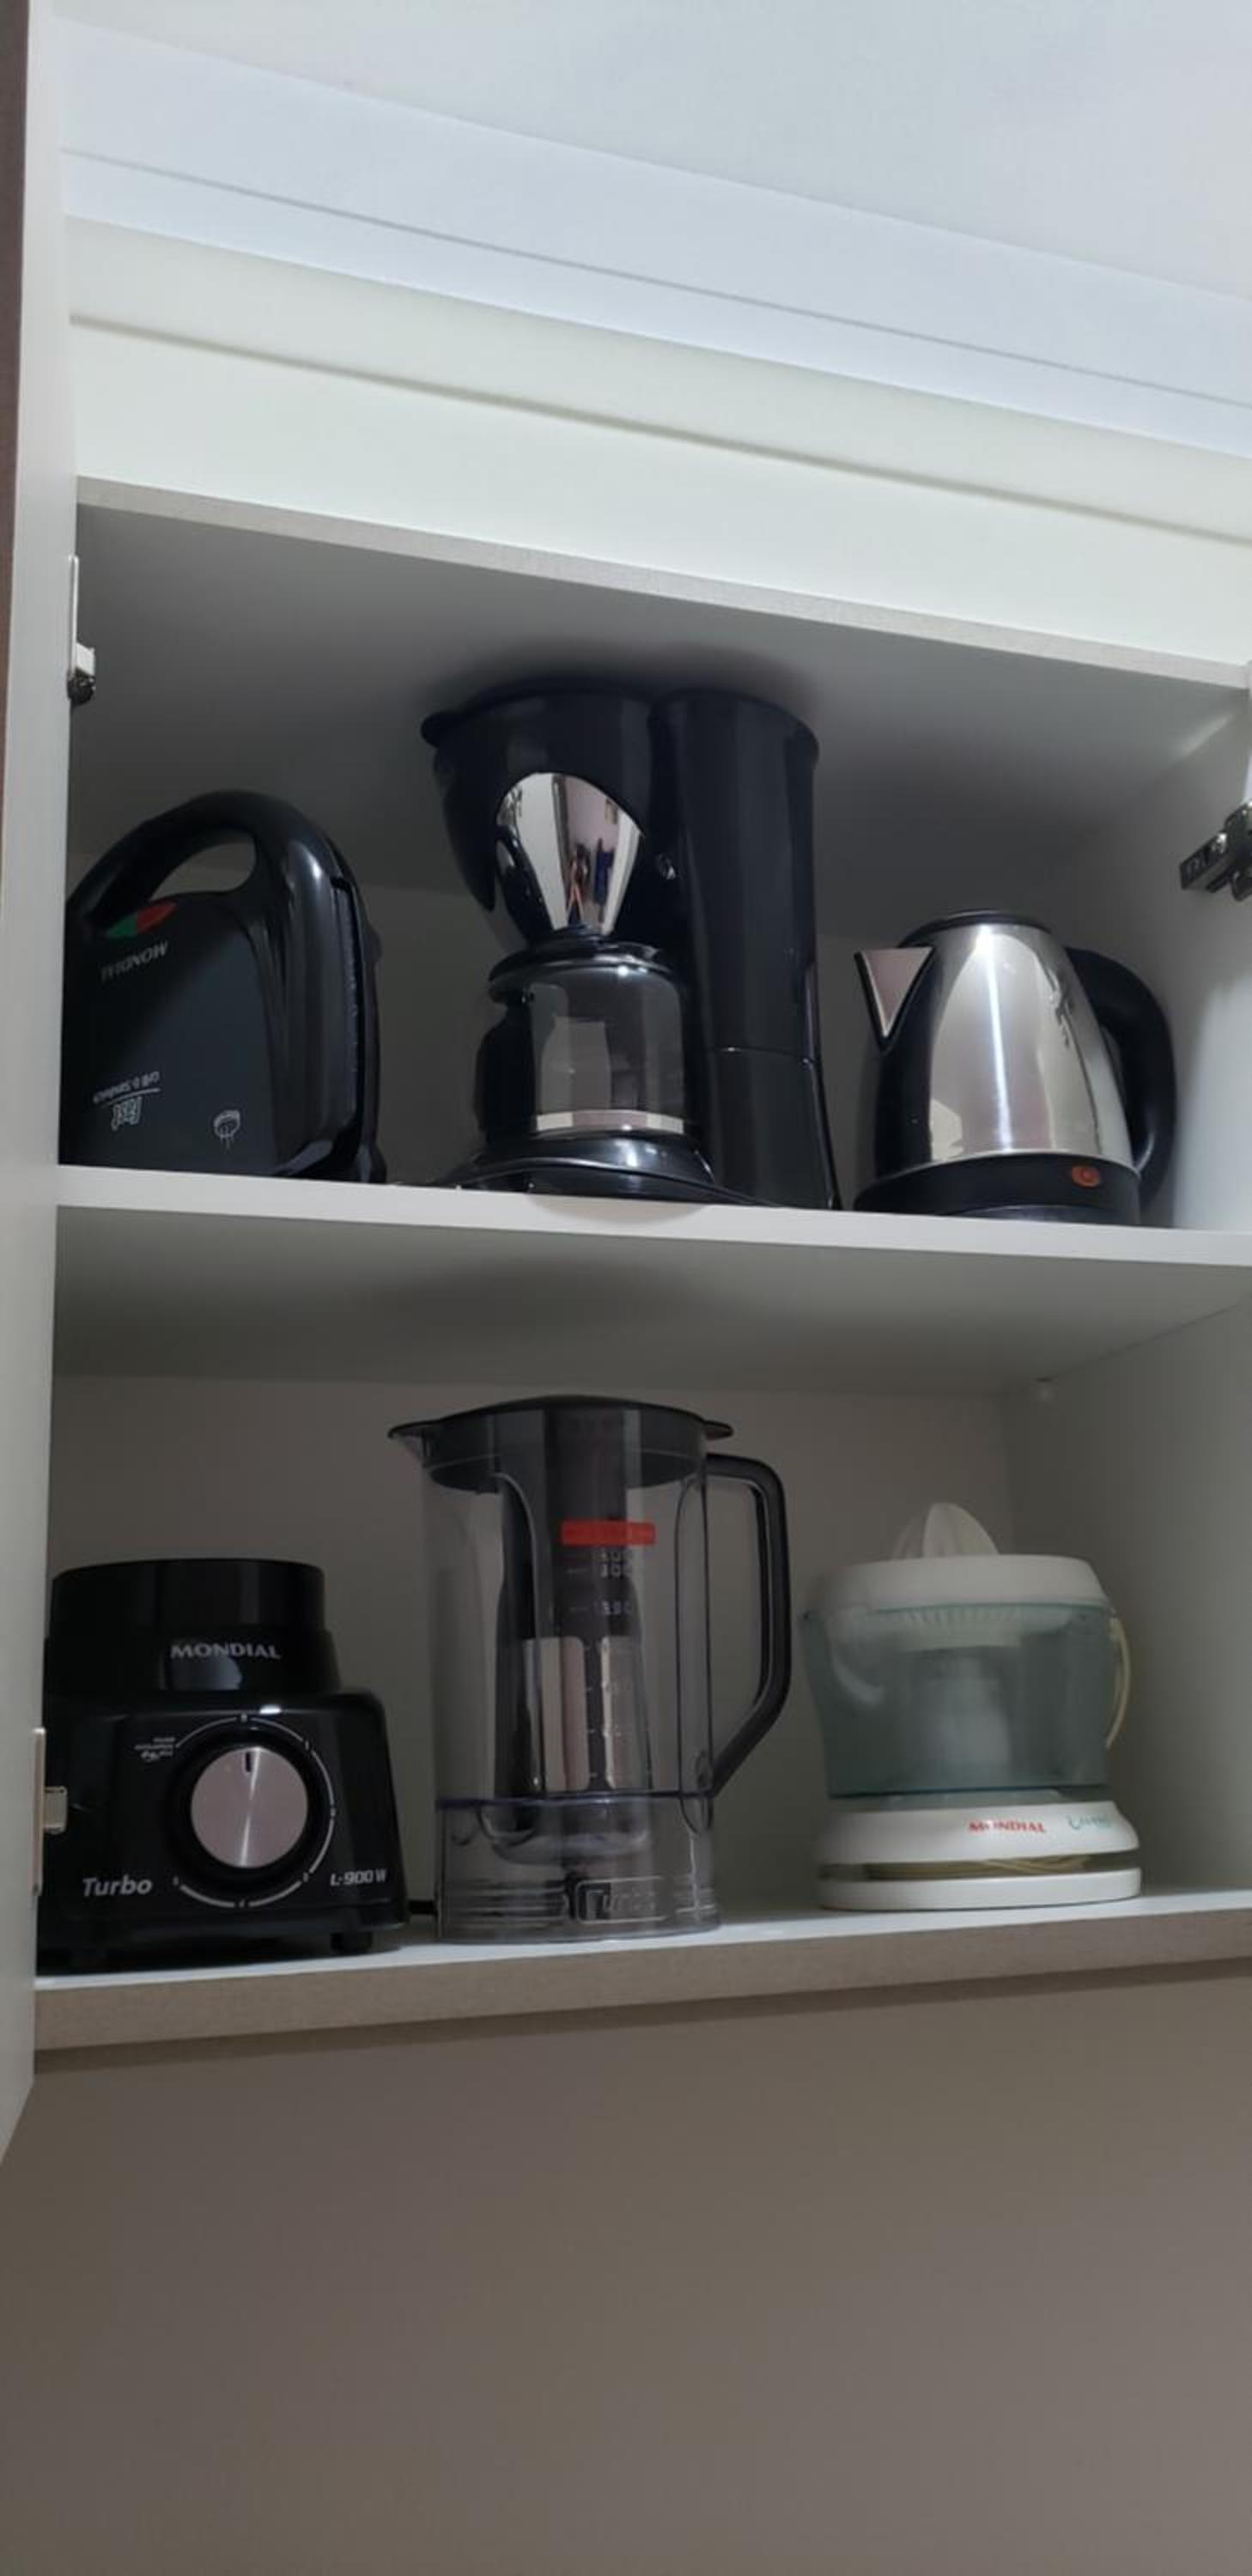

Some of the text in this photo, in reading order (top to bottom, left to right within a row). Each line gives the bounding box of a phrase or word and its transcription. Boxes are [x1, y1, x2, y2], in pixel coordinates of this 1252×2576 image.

[100, 939, 169, 984] MONDIAL
[170, 1643, 282, 1659] MONDIAL
[968, 1818, 1047, 1833] MONDIAL
[82, 1874, 153, 1897] Turbo
